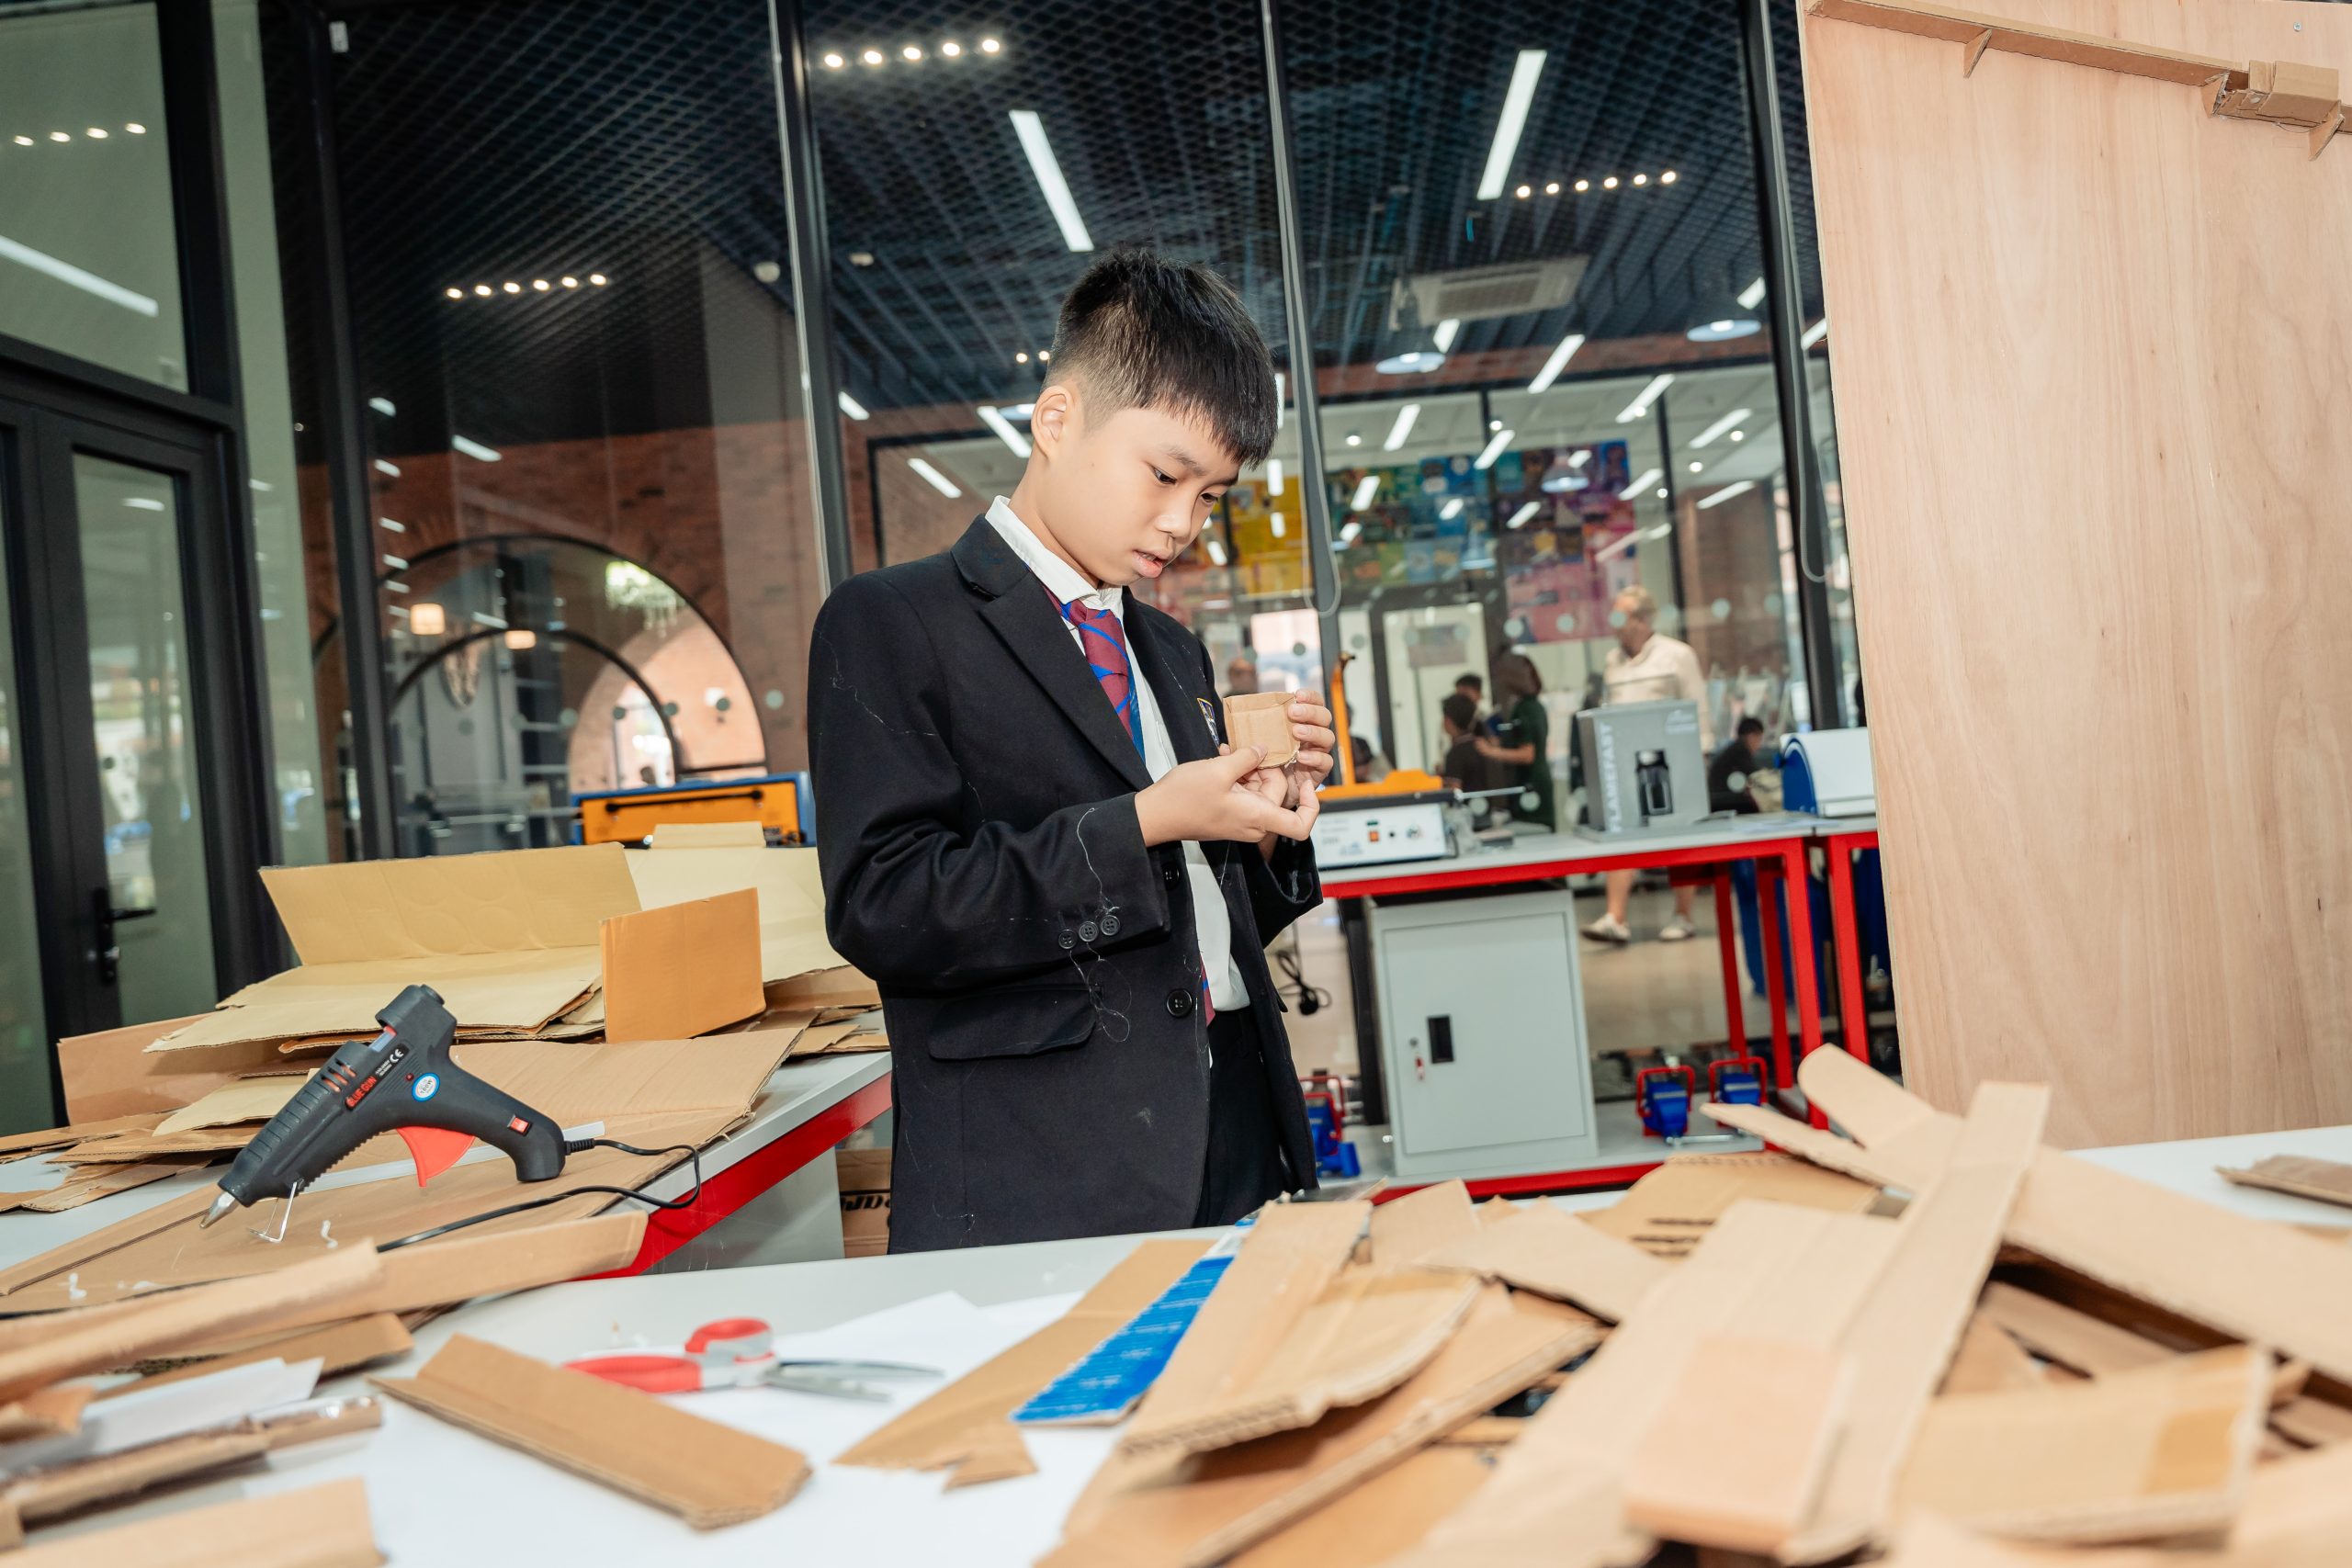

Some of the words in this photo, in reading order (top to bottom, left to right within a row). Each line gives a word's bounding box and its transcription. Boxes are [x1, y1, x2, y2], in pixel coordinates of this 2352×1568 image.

[1599, 721, 1623, 833] FLAMEFAST
[345, 1088, 366, 1108] GLUE
[360, 1076, 378, 1091] GUN
